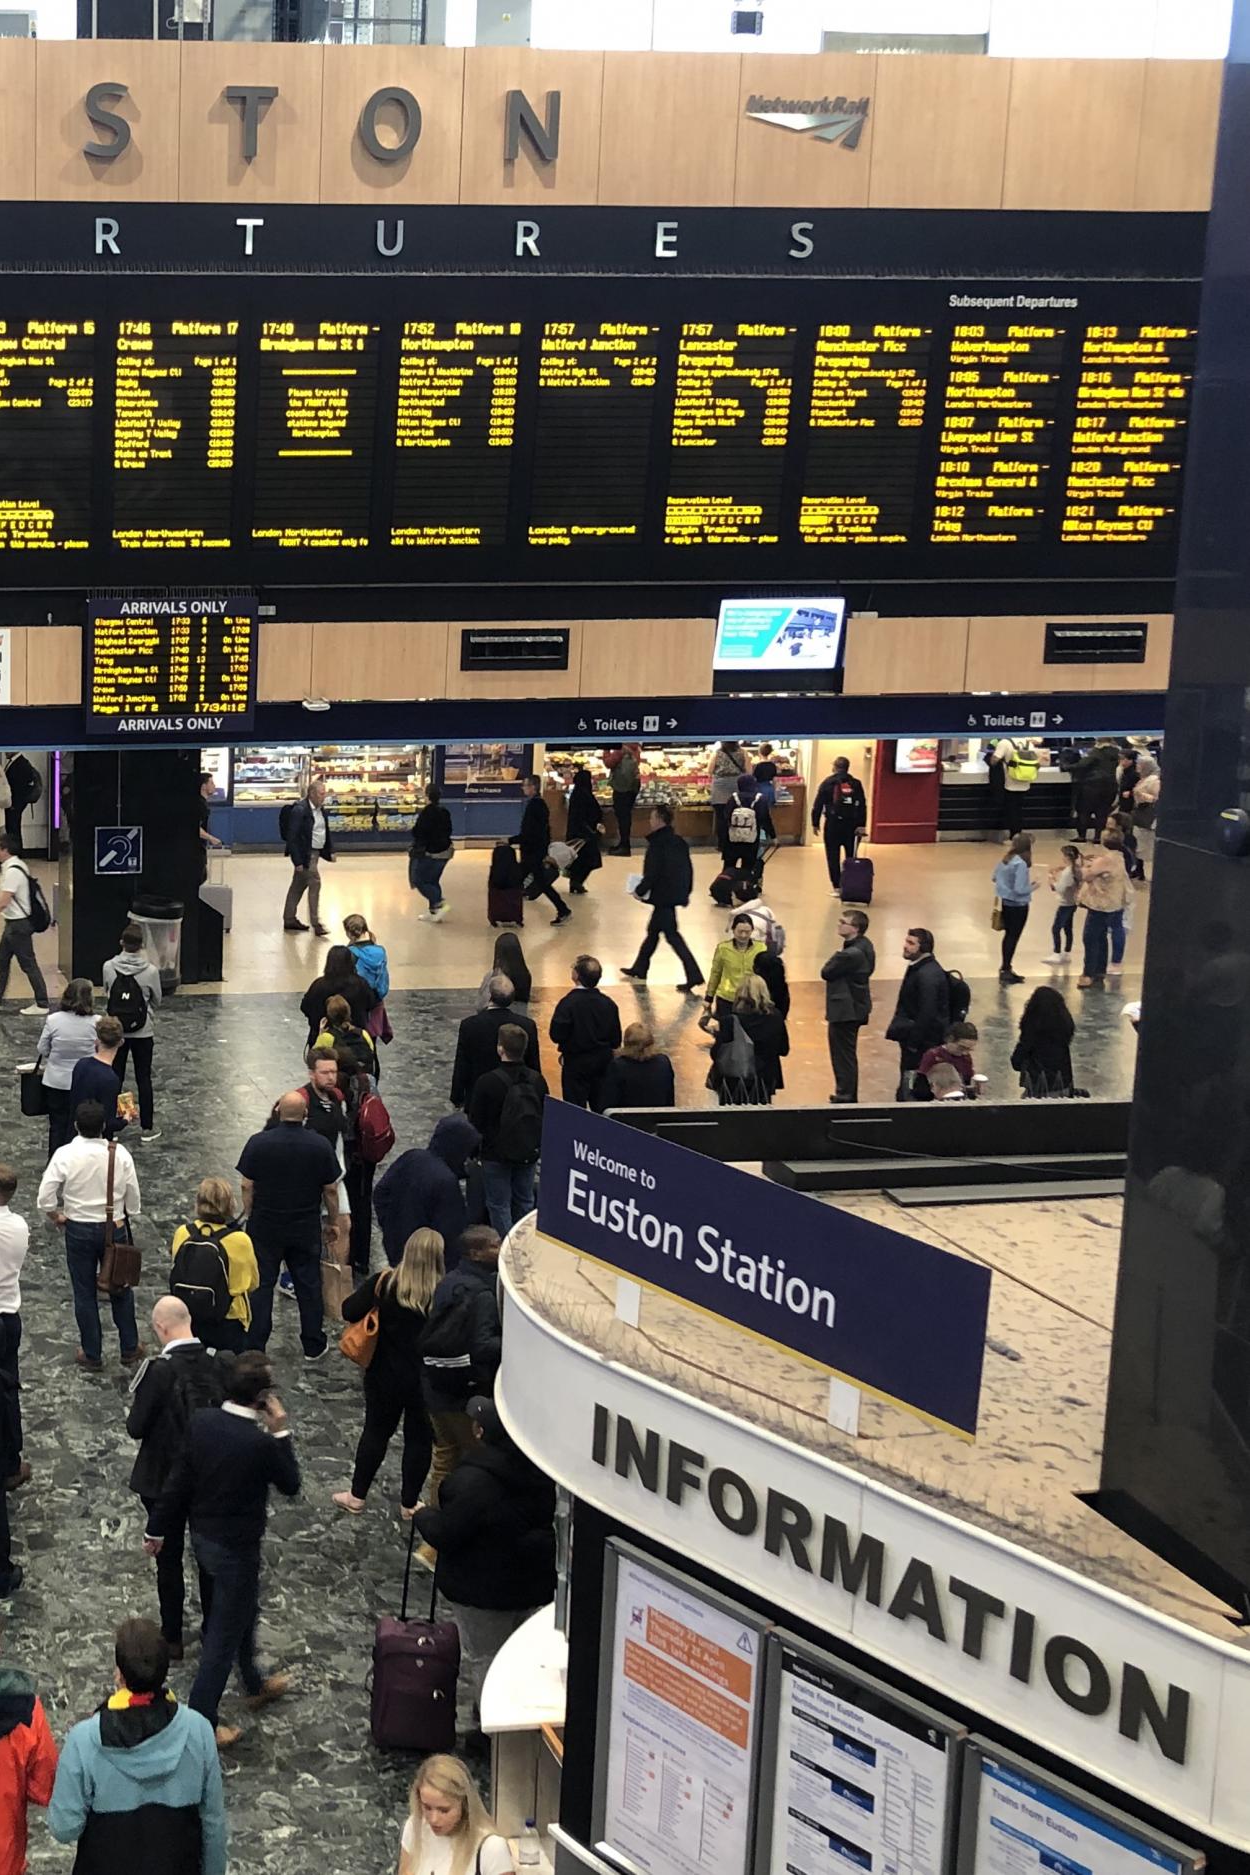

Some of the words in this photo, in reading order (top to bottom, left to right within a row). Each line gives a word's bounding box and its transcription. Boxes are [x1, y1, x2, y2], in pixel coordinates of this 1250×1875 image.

[948, 295, 1014, 309] Subsequent
[1016, 295, 1078, 309] Departures
[28, 321, 77, 334] Platform
[120, 322, 151, 335] 17:46
[172, 322, 221, 335] Platform
[227, 322, 238, 334] 17
[263, 323, 294, 335] 17:49
[320, 323, 368, 335] Platform
[405, 323, 435, 335] 17:52
[456, 323, 504, 335] Platform
[545, 323, 575, 335] 17:57
[600, 323, 648, 335] Platform
[683, 324, 713, 336] 17:57
[738, 324, 785, 336] Platform
[820, 325, 850, 337] 18:00
[874, 325, 921, 337] Platform
[955, 326, 985, 337] 18:03
[1008, 326, 1055, 337] Platform
[1087, 327, 1118, 338] 18:13
[22, 337, 66, 350] Central
[402, 338, 474, 351] Northampton
[542, 339, 586, 350] Watford
[590, 339, 636, 350] Junction
[680, 339, 737, 351] Lancaster
[816, 340, 880, 352] Manchester
[883, 340, 907, 352] Picc
[1083, 342, 1155, 354] Northampton
[678, 354, 734, 369] Preparing
[815, 355, 870, 370] Preparing
[1082, 372, 1112, 383] 18:16
[946, 386, 1016, 399] Northampton
[945, 417, 975, 428] 18:07
[1076, 417, 1106, 428] 18:17
[941, 432, 992, 444] Liverpool
[994, 432, 1018, 442] Lime
[1021, 431, 1034, 442] St
[1073, 432, 1116, 443] Watford
[1118, 432, 1164, 442] Junction
[1067, 476, 1129, 487] Manchester
[1132, 476, 1155, 486] Picc
[936, 506, 965, 517] 18:12
[933, 520, 961, 532] Tring
[120, 601, 187, 615] ARRIVALS
[190, 600, 228, 614] ONLY
[93, 705, 119, 714] Page
[135, 704, 146, 712] of
[195, 703, 245, 712] 17:34:12
[117, 717, 183, 732] ARRIVALS
[186, 717, 224, 730] ONLY
[593, 716, 638, 732] Toilets
[982, 712, 1026, 728] Toilets
[572, 1139, 637, 1184] Welcome
[638, 1170, 657, 1191] to
[565, 1167, 686, 1261] Euston
[693, 1223, 838, 1329] Station
[591, 1401, 1191, 1767] INFORMATION
[792, 1679, 815, 1700] Trains
[816, 1693, 836, 1710] from
[837, 1702, 865, 1724] Euston
[991, 1788, 1019, 1811] Trains
[1020, 1803, 1044, 1823] from
[1045, 1817, 1079, 1842] Euston
